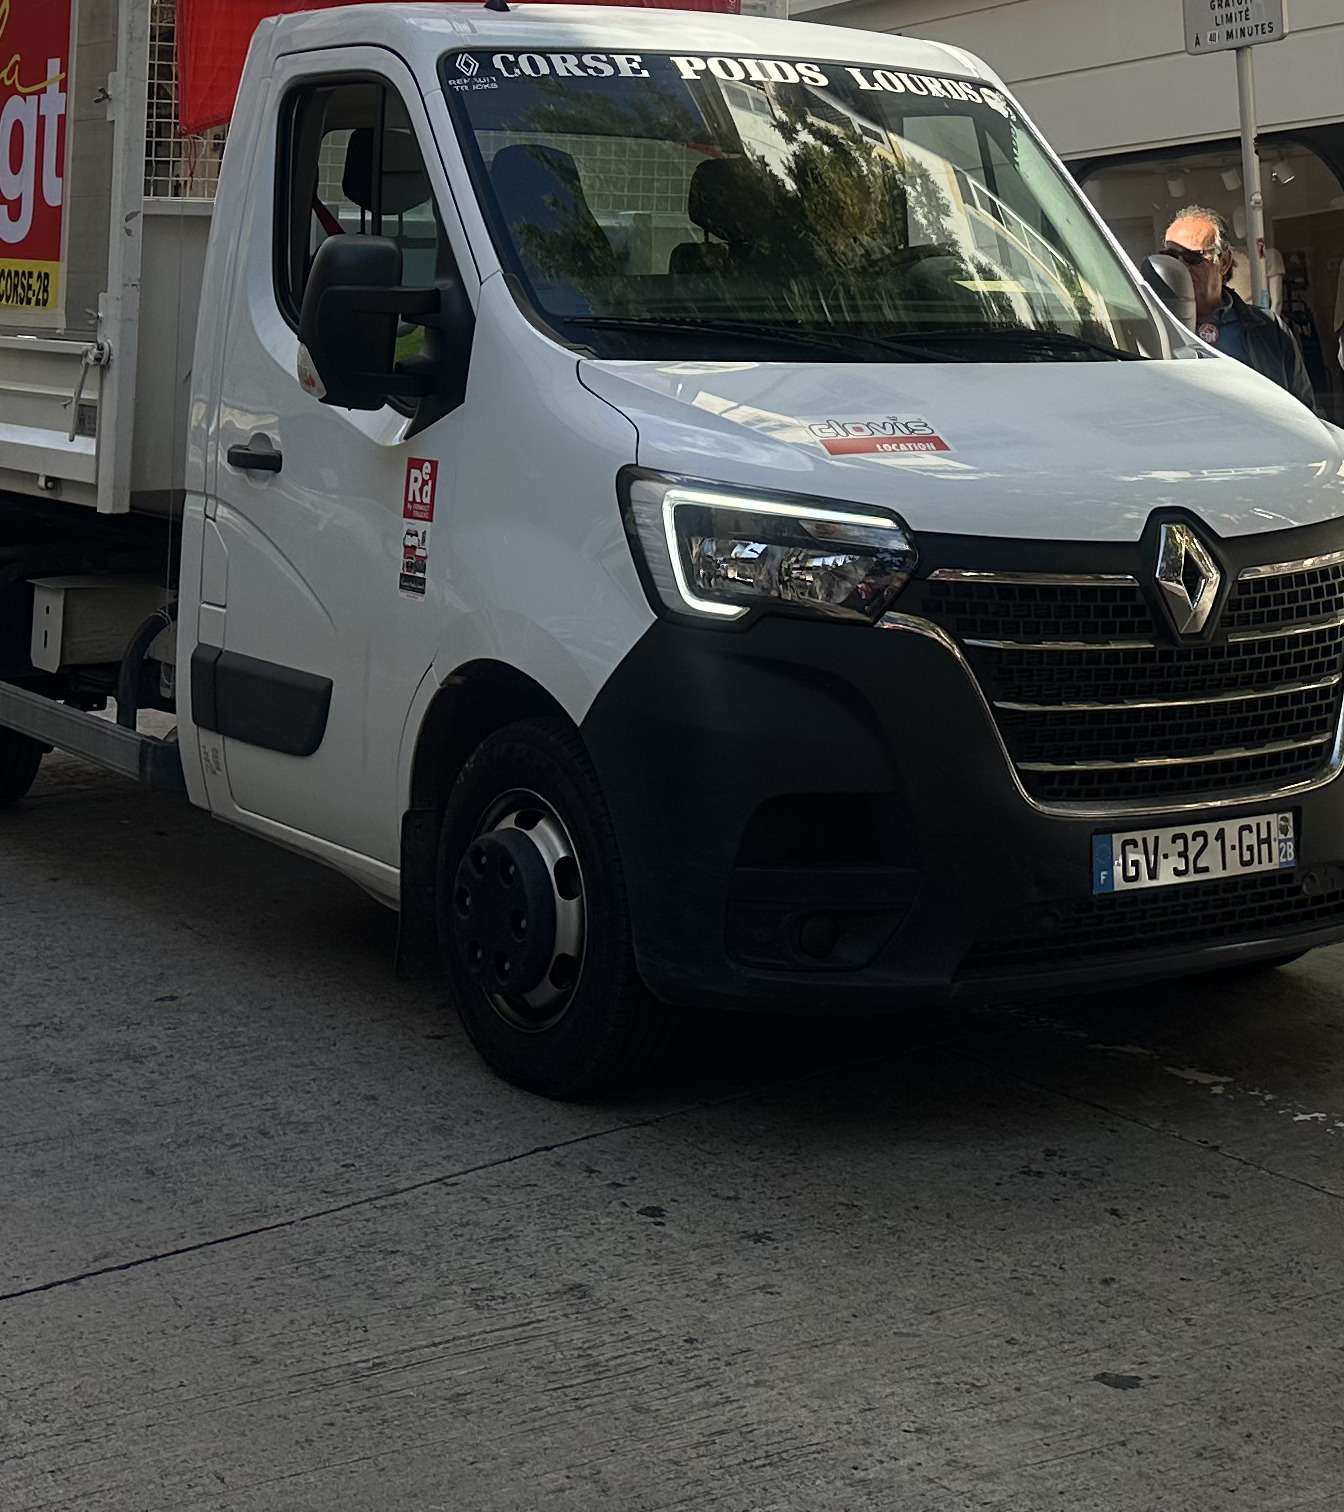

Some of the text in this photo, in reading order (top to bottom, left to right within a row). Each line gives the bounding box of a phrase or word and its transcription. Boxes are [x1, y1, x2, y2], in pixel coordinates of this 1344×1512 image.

[1215, 7, 1251, 26] LIMITÉ
[1226, 22, 1274, 41] MINUTES
[493, 53, 983, 104] CORSE POIDS LOURDS
[808, 416, 934, 438] clovis
[876, 442, 937, 452] LOCATION
[1100, 821, 1295, 885] F GV-321-GH 2B
